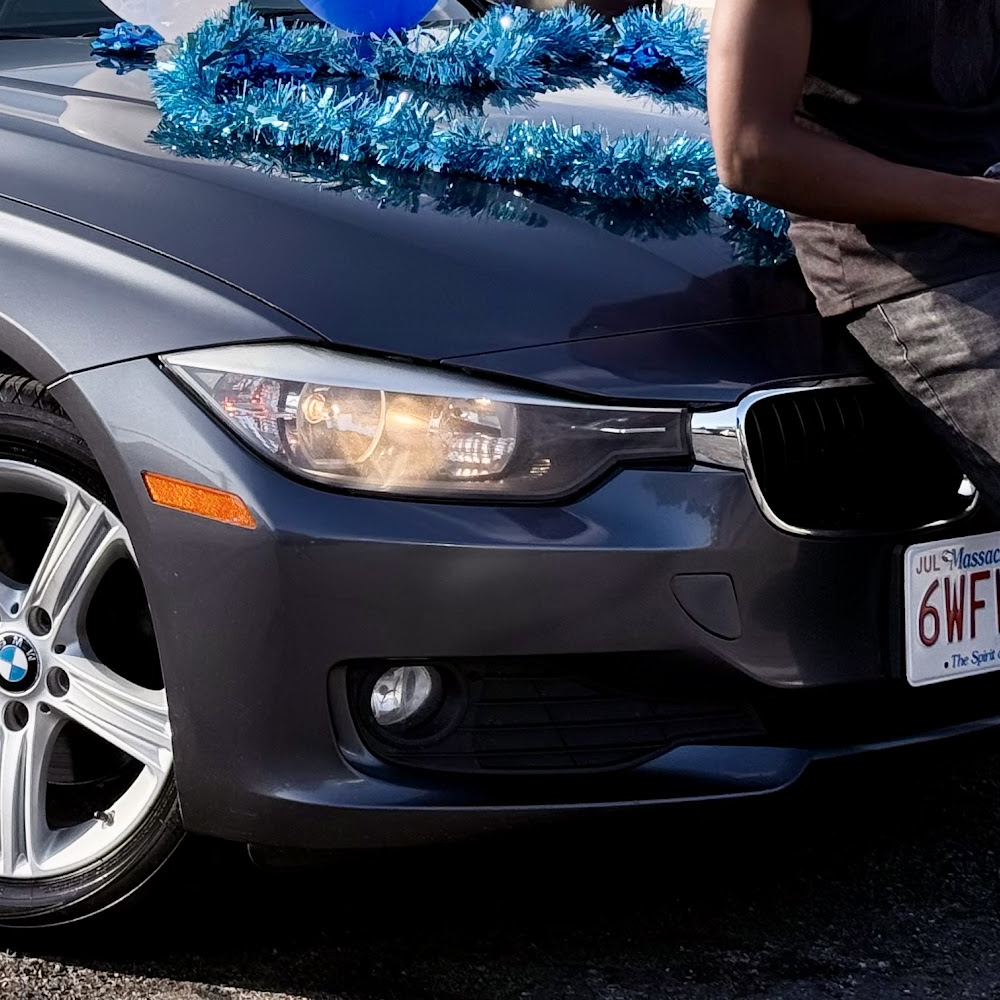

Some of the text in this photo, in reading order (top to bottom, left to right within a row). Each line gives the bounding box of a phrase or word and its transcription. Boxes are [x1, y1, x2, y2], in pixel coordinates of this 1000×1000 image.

[916, 554, 941, 575] JUL
[951, 653, 970, 668] The
[970, 649, 996, 666] Spirit
